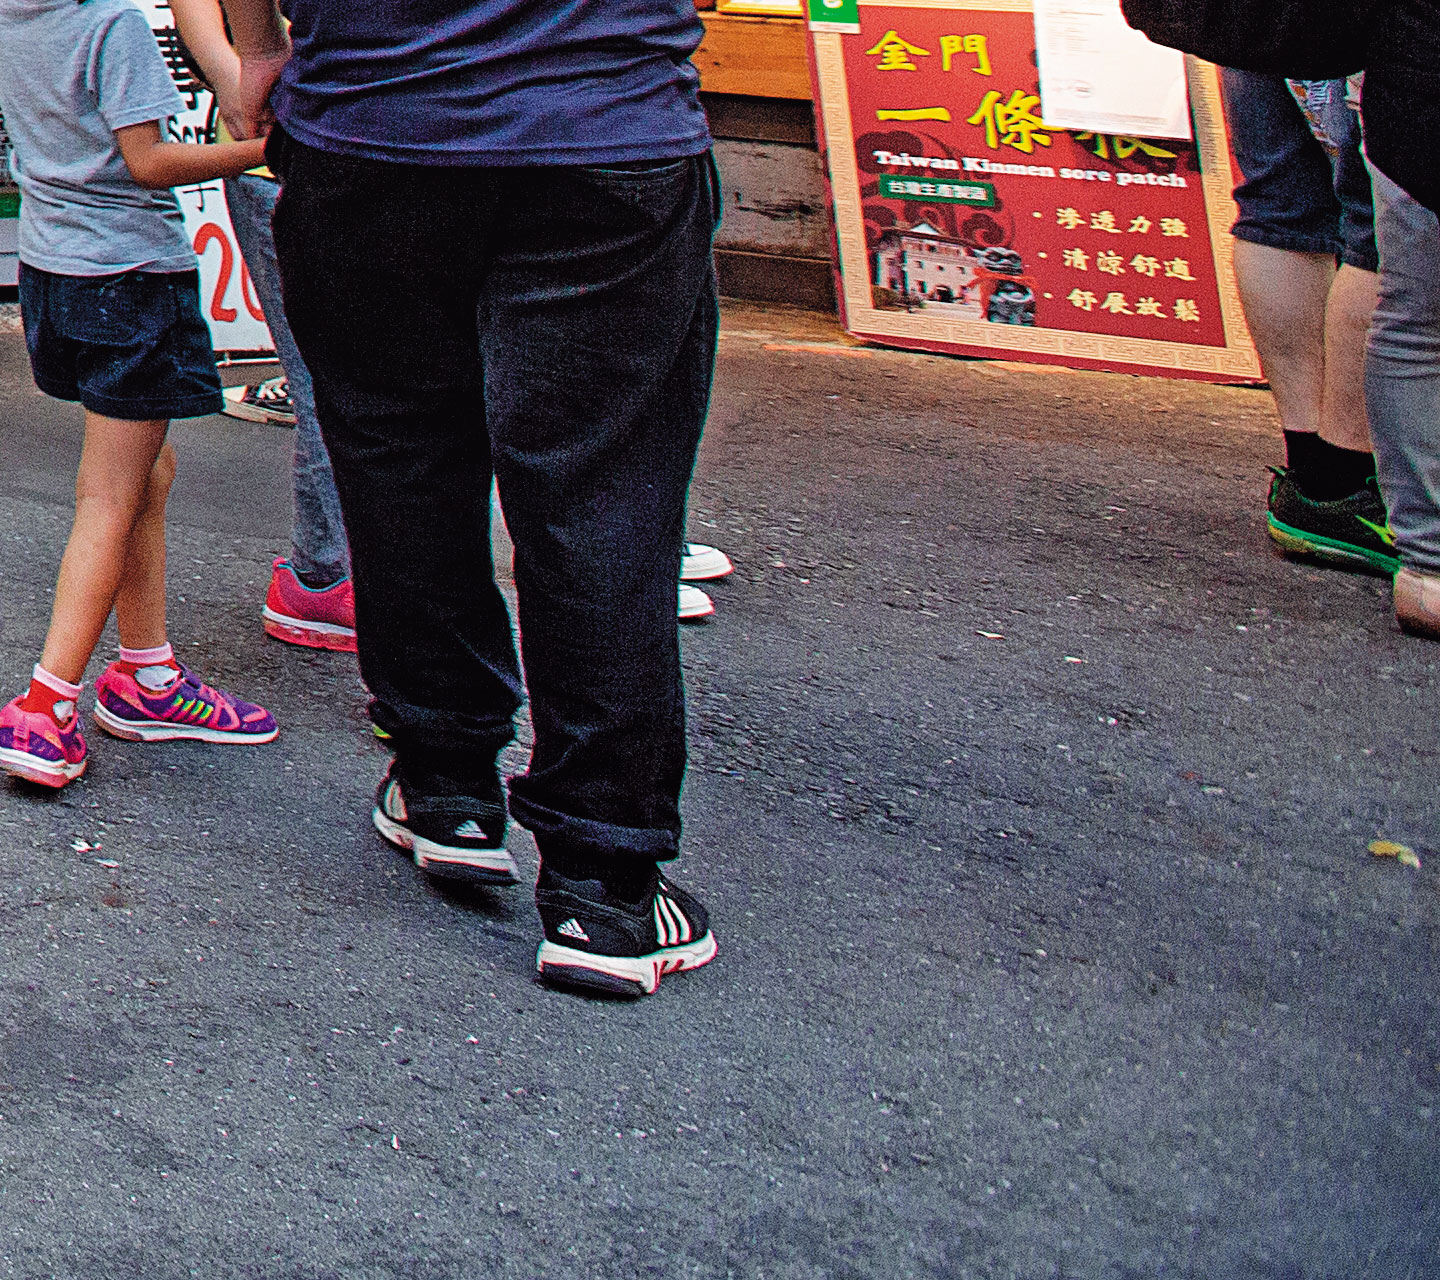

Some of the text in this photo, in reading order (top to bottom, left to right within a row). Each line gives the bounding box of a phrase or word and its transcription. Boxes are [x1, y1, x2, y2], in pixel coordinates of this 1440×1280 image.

[866, 30, 993, 76] 金門
[873, 151, 1188, 189] Taiwan Kinmen sore patch
[1056, 207, 1190, 239] 滲透力強
